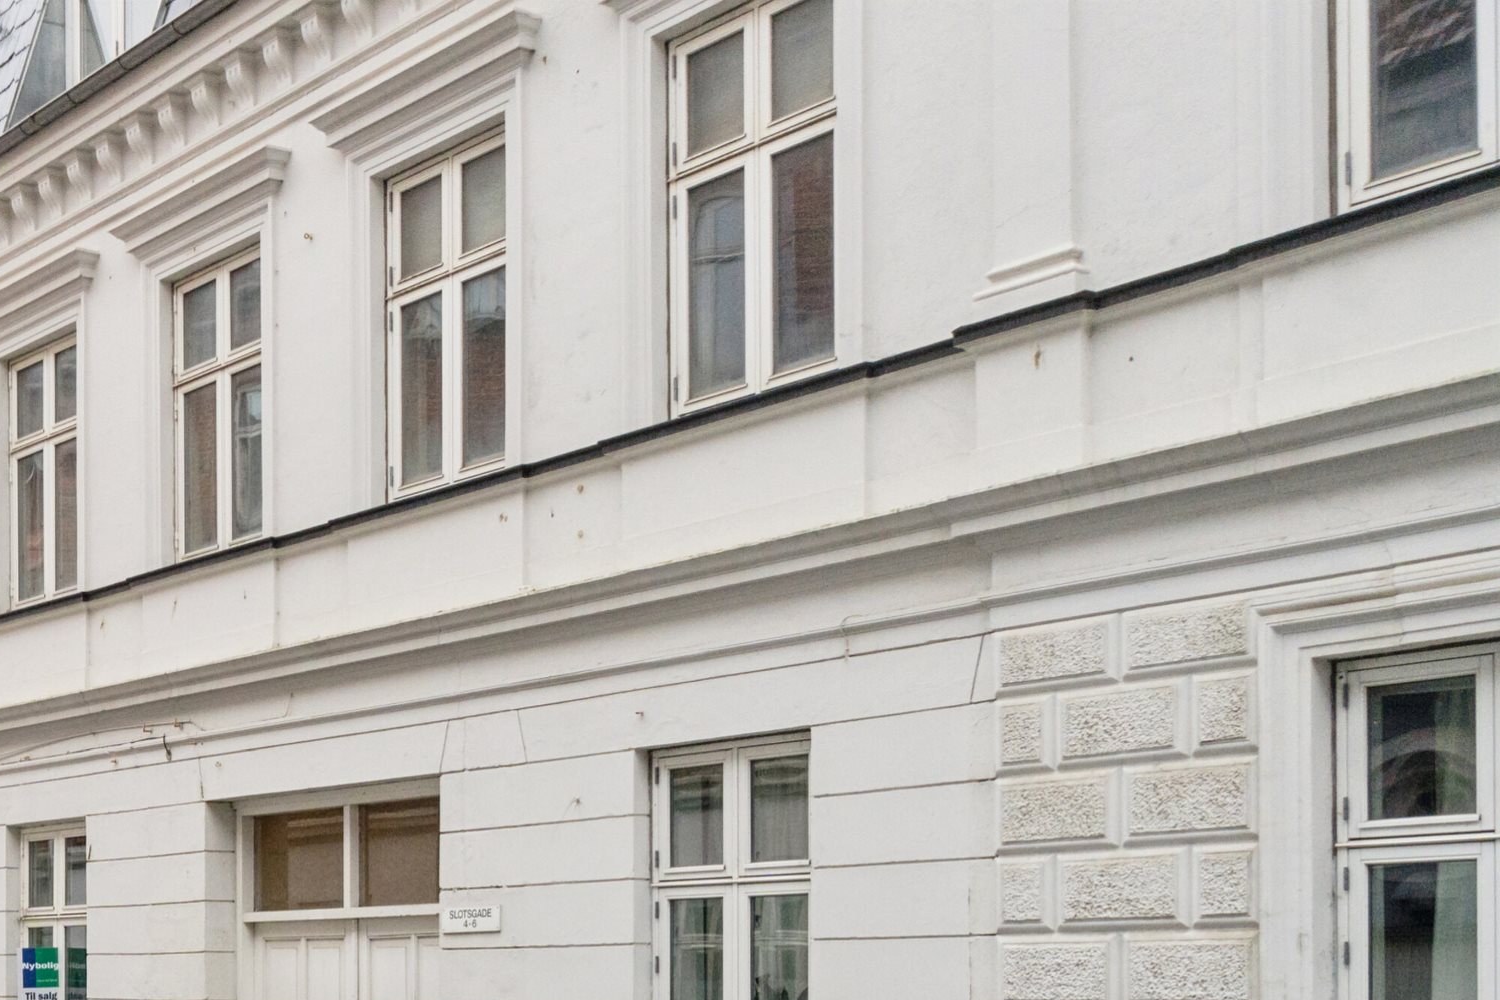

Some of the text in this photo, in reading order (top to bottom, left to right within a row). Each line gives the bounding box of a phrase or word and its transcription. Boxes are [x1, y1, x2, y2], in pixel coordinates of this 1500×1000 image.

[450, 909, 491, 919] SLOTSGADE
[22, 962, 59, 971] Nybolig
[25, 992, 58, 1000] Til salg
